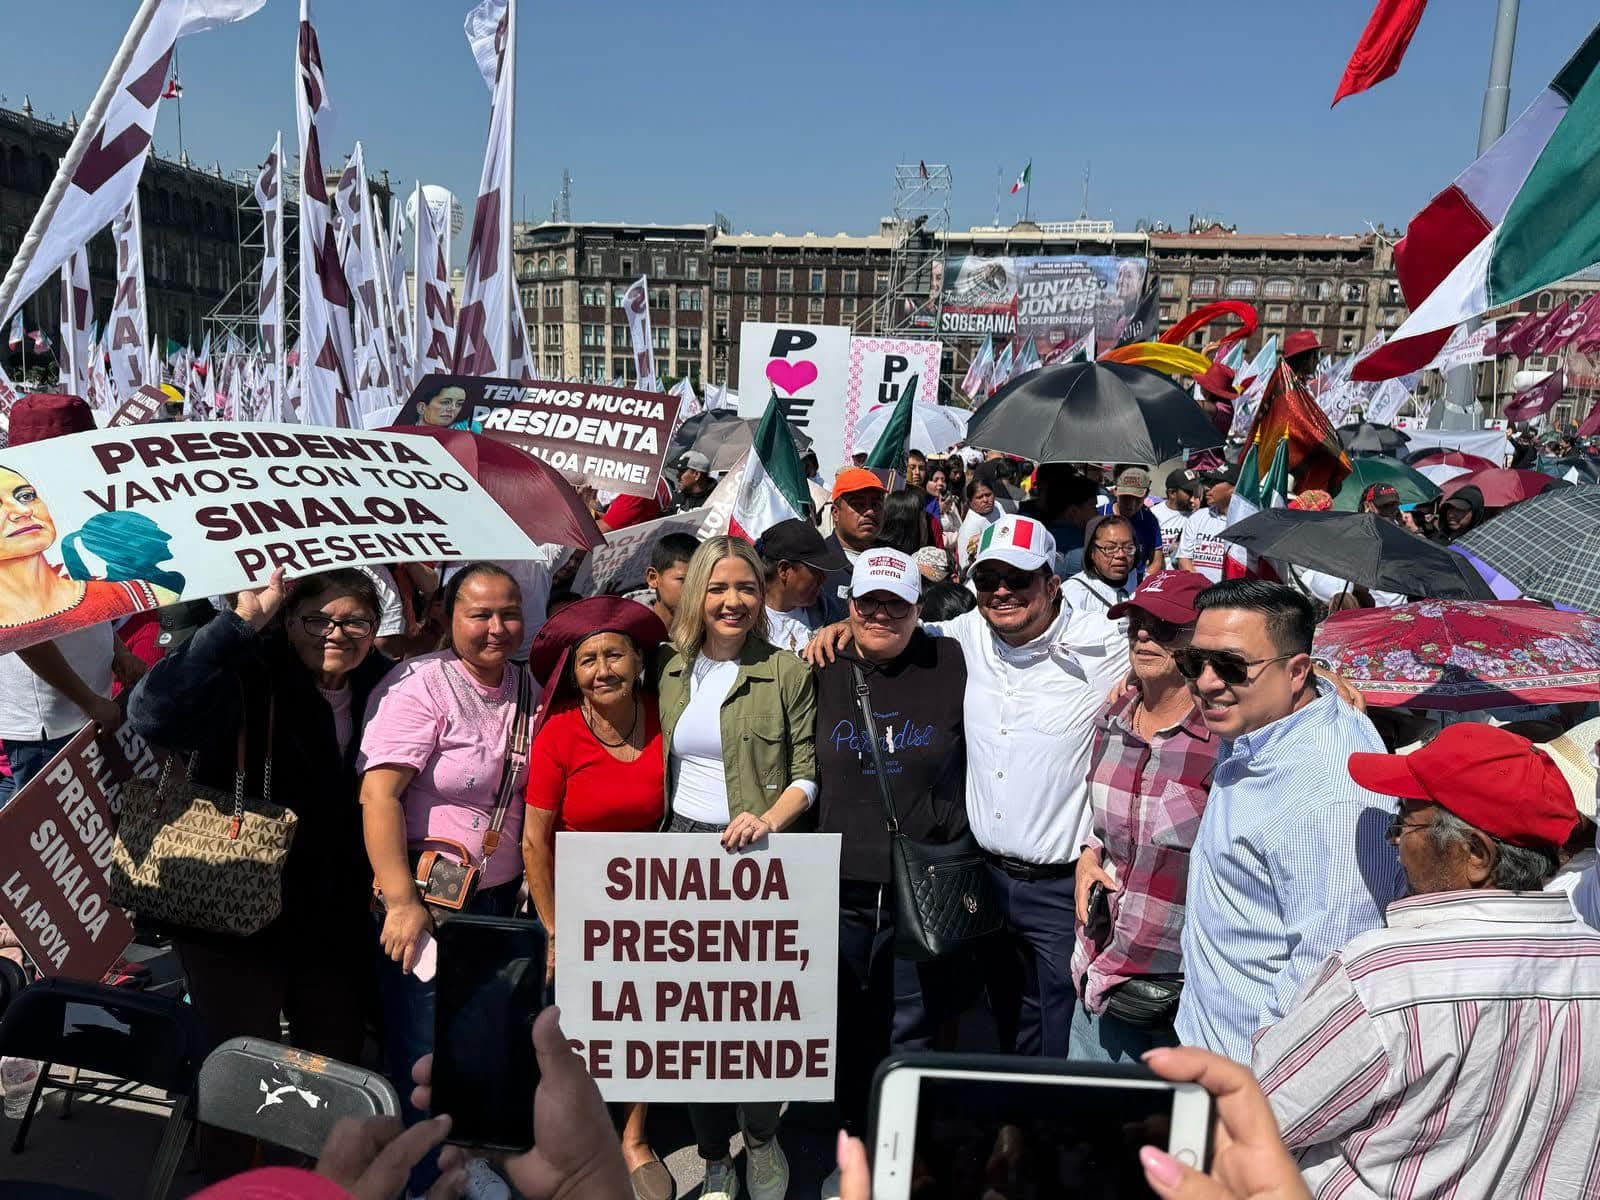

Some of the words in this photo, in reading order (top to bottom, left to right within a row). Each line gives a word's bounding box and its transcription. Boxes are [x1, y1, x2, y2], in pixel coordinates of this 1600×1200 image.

[1017, 276, 1098, 299] JUNTAS
[1017, 292, 1097, 316] JUNTOS
[941, 311, 1017, 333] SOBERANÍA
[483, 384, 584, 409] TENEMOS
[585, 393, 665, 421] MUCHA
[472, 404, 659, 455] PRESIDENTA
[91, 431, 432, 475] PRESIDENTA
[582, 455, 650, 485] FIRME!
[83, 466, 259, 513] VAMOS
[267, 465, 362, 488] CON
[361, 467, 469, 492] TODO
[195, 496, 449, 541] SINALOA
[234, 532, 463, 582] PRESENTE
[44, 758, 113, 886] PRESID
[30, 818, 110, 943] SINALOA
[604, 857, 790, 901] SINALOA
[1, 870, 31, 910] LA
[20, 900, 71, 970] APOYA
[583, 919, 810, 971] PRESENTE,
[591, 981, 643, 1022] LA
[655, 980, 801, 1022] PATRIA
[625, 1038, 830, 1080] DEFIENDE
